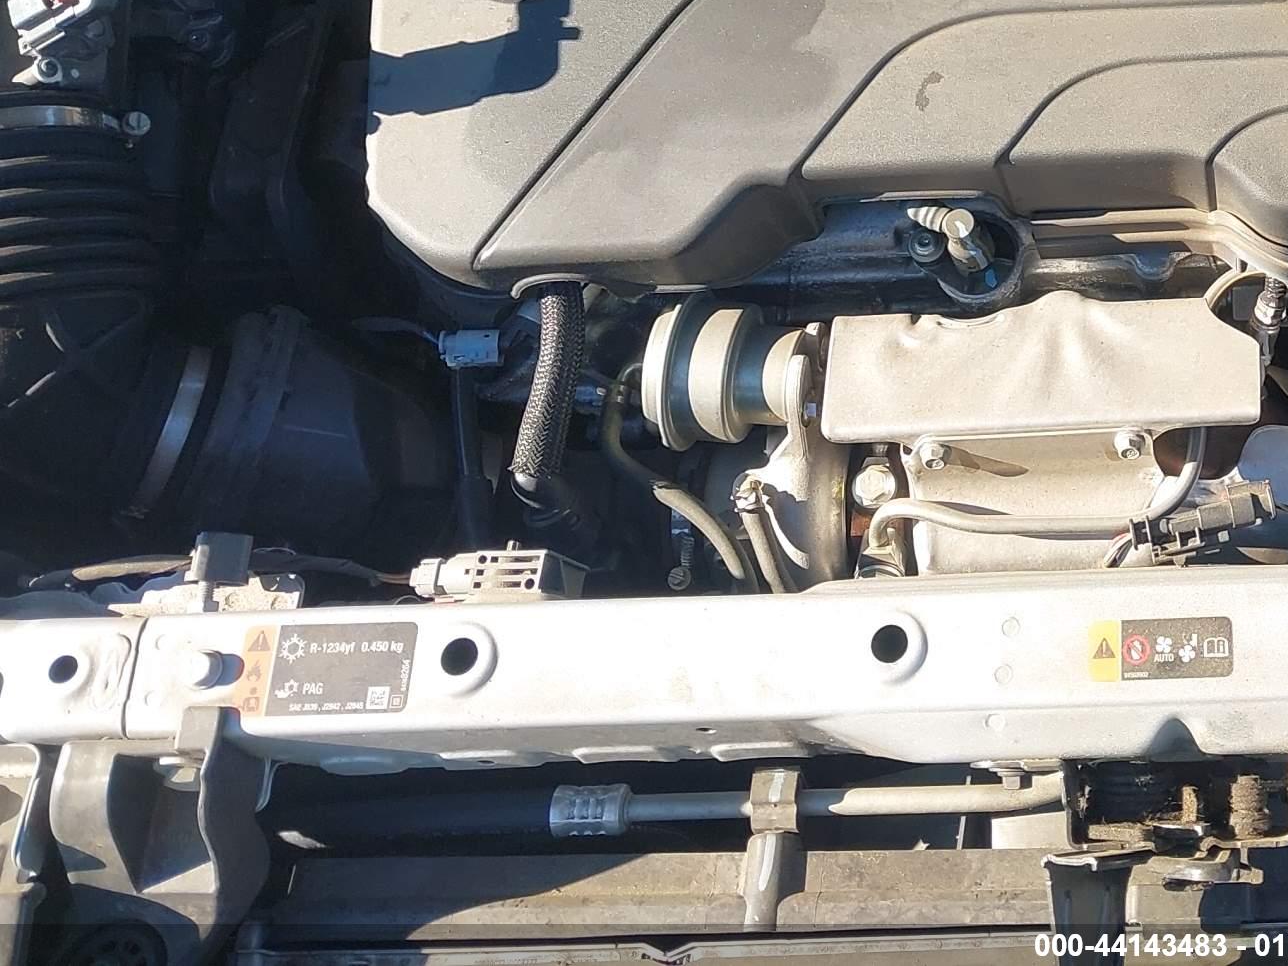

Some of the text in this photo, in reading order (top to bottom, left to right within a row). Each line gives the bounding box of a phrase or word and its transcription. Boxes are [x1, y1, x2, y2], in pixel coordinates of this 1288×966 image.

[309, 640, 404, 655] R-1234yf 0.450 kg
[1153, 653, 1175, 663] AUTO
[302, 682, 324, 695] PAG
